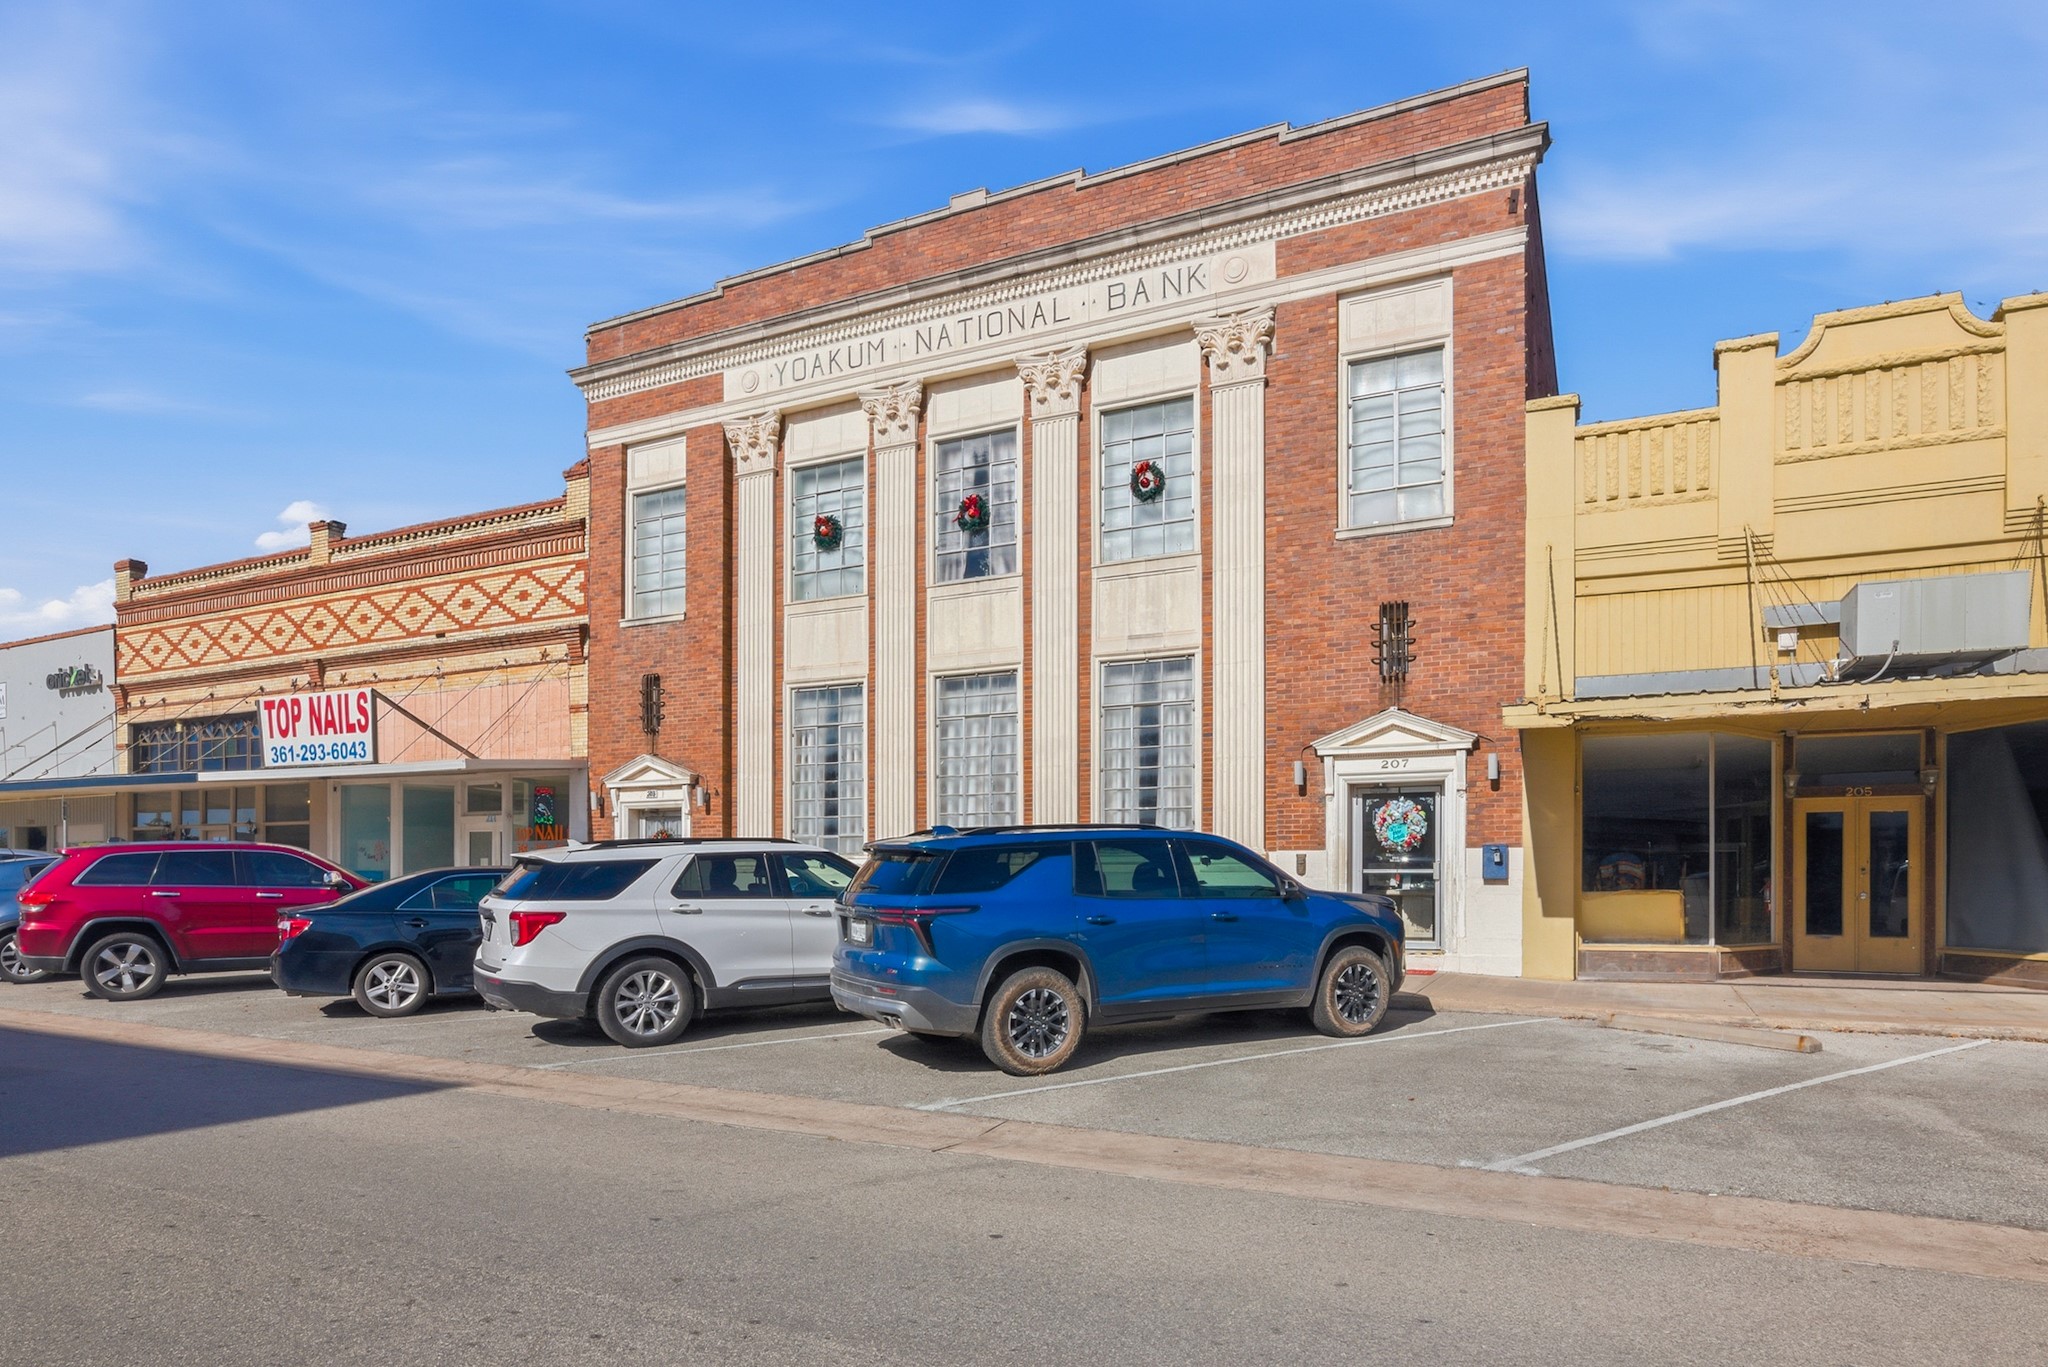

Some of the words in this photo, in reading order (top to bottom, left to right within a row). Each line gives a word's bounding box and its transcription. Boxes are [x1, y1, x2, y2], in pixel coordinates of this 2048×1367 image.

[775, 337, 885, 387] YOAKUM
[915, 297, 1071, 355] NATIONAL
[1107, 262, 1207, 312] BANK
[263, 697, 302, 739] TOP
[308, 691, 370, 737] NAILS
[270, 740, 367, 764] 361-293-6043
[1381, 758, 1409, 769] 207
[1845, 786, 1873, 797] 205
